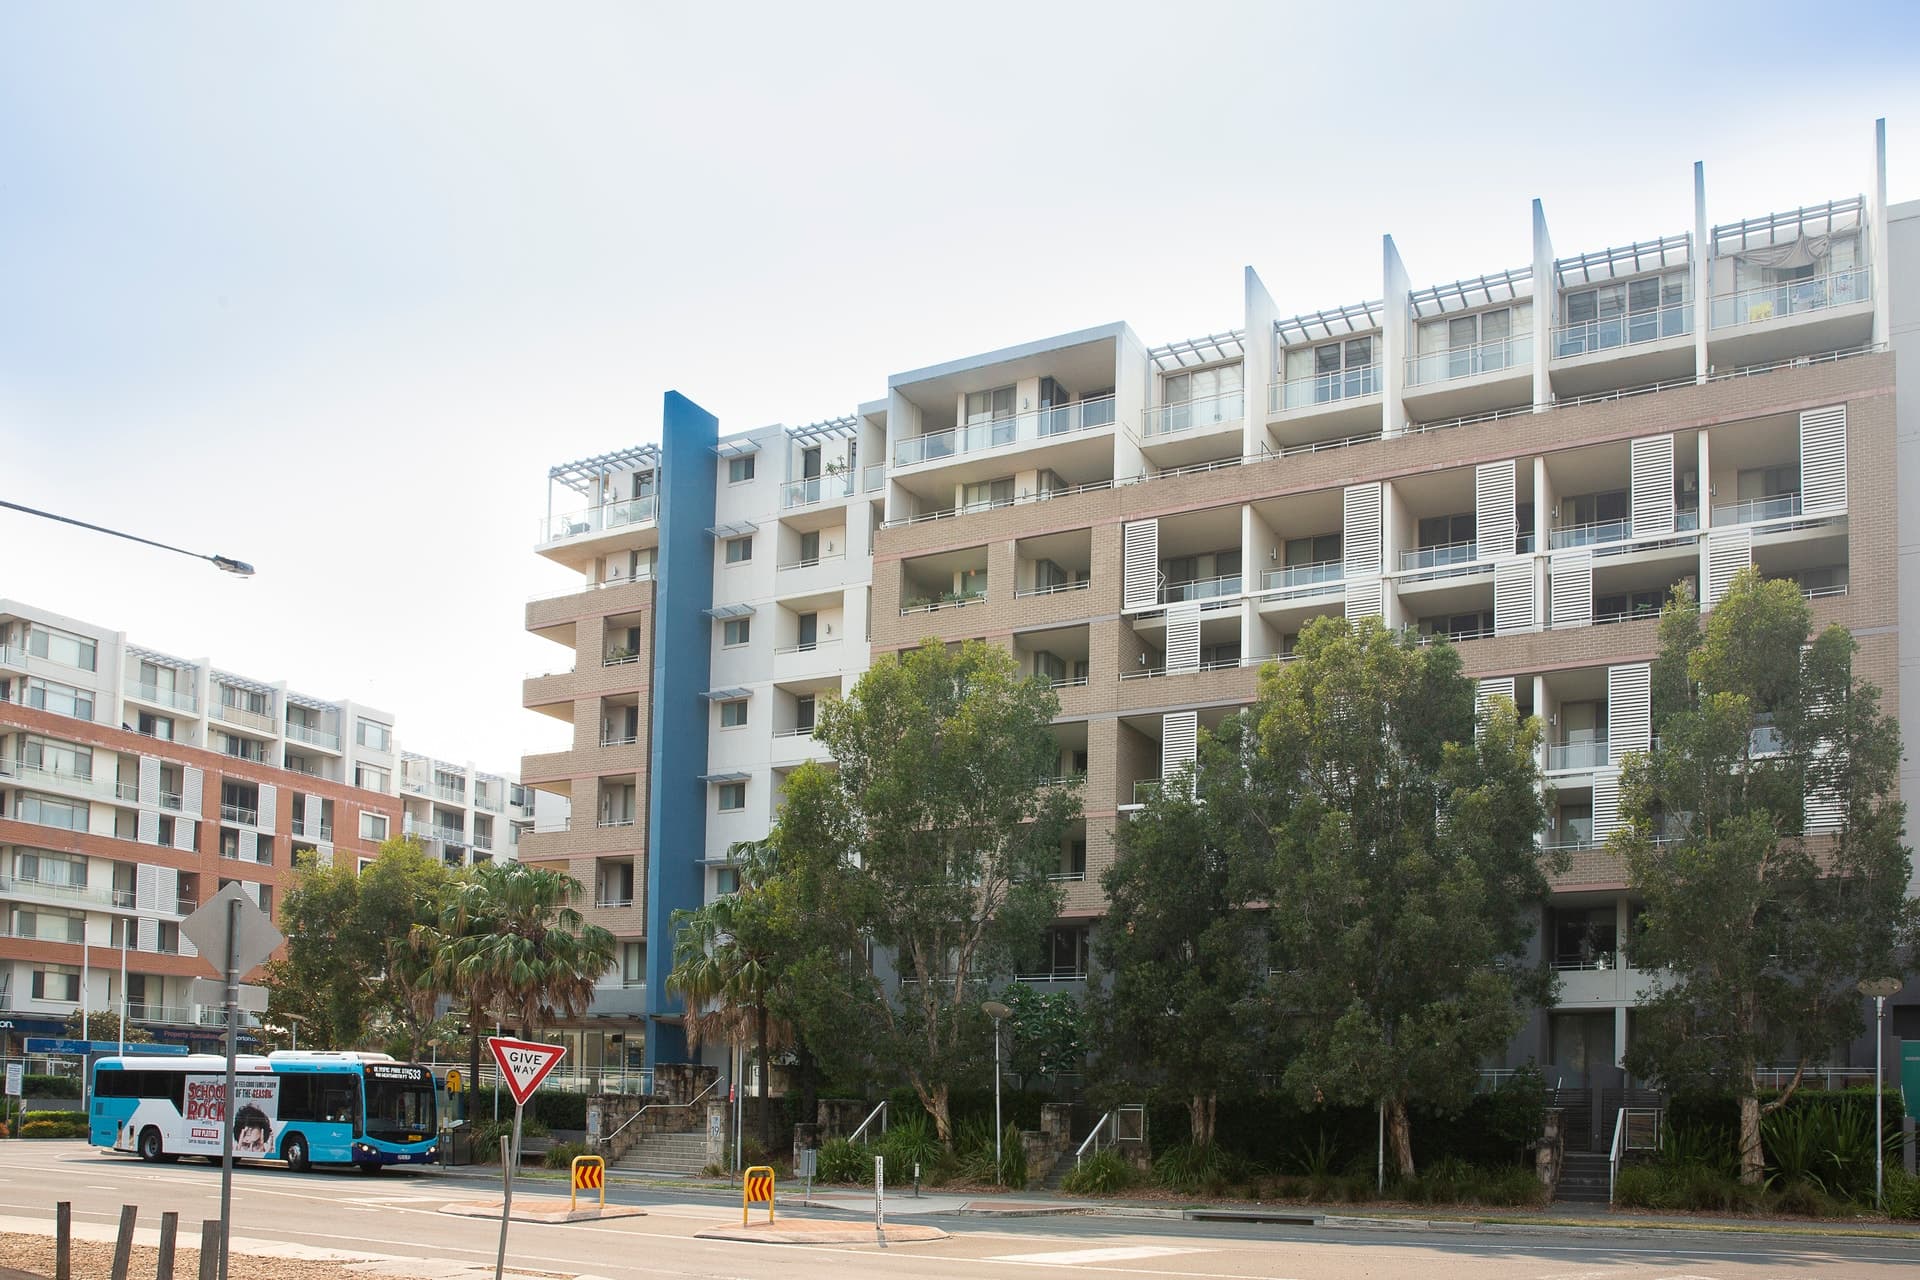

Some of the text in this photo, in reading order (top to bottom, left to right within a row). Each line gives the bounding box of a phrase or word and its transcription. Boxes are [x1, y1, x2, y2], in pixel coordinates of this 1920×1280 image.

[509, 1052, 543, 1066] GIVE
[409, 1069, 421, 1080] 533
[513, 1064, 536, 1075] WAY
[243, 1089, 251, 1098] THE
[187, 1101, 225, 1121] ROCK
